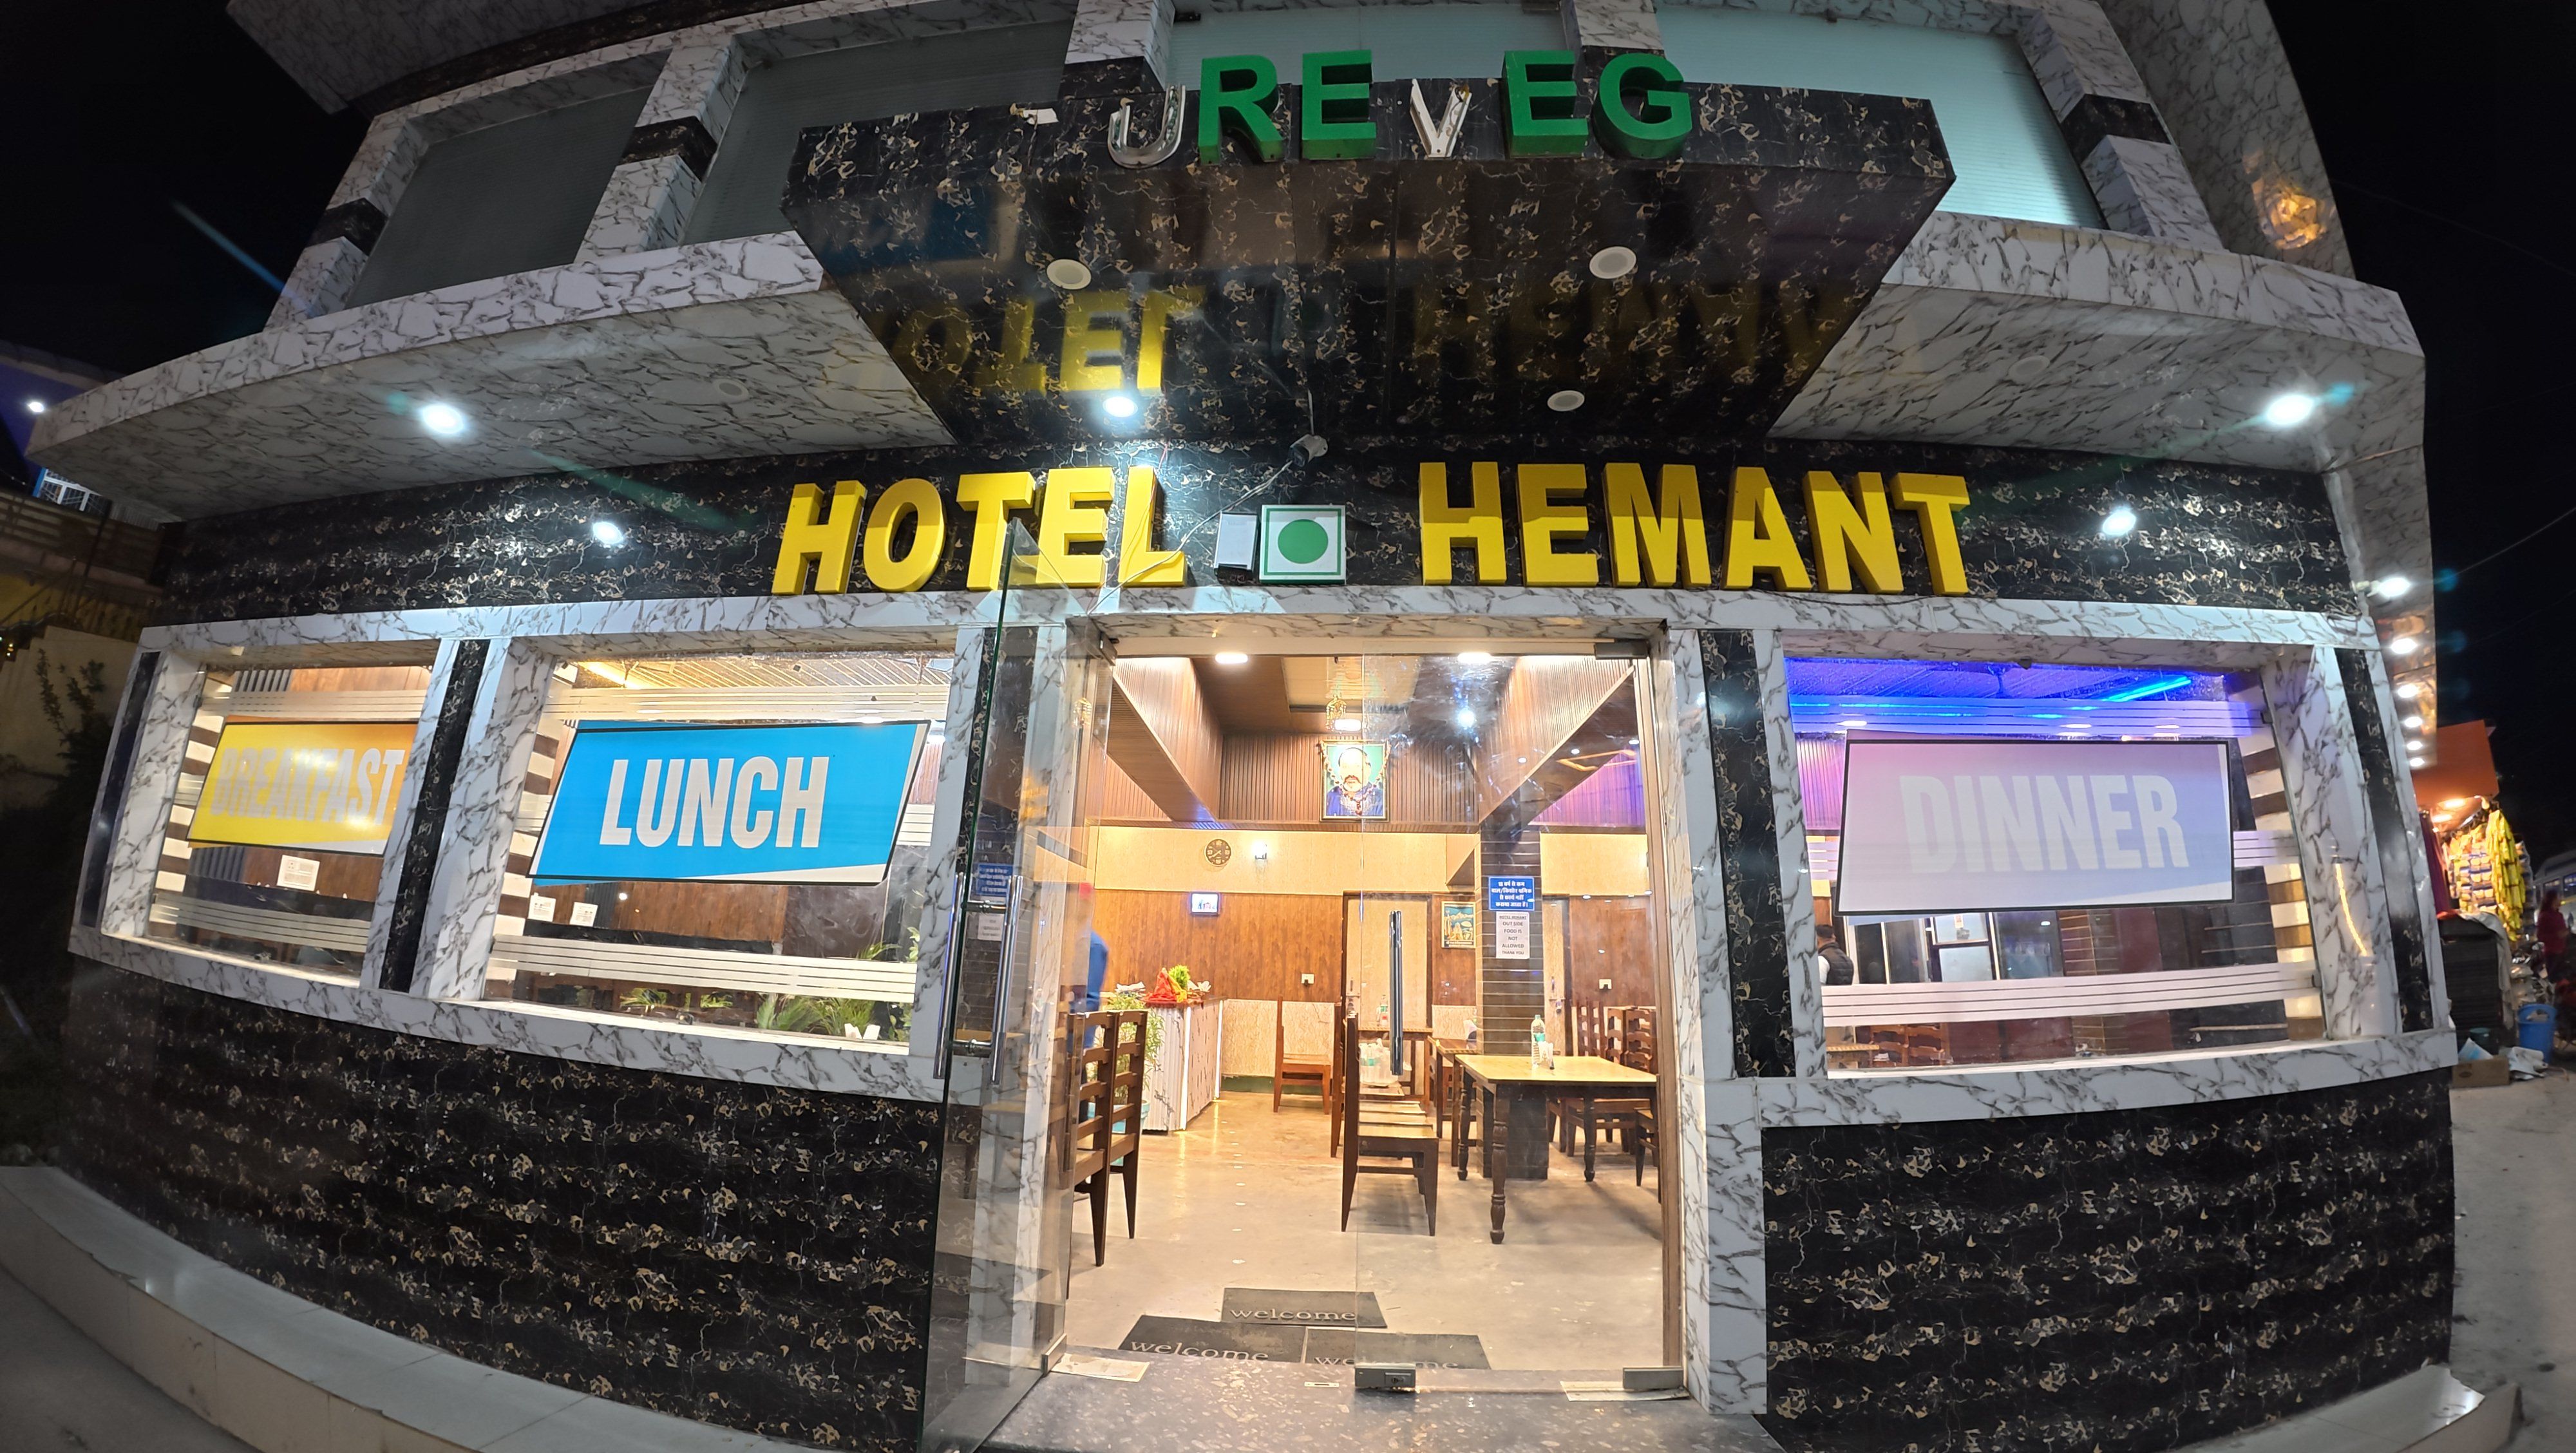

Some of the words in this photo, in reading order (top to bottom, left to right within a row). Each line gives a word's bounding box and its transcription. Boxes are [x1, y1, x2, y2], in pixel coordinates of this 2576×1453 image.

[1410, 50, 1693, 160] VEG
[772, 465, 1187, 594] HOTEL
[1419, 461, 1970, 595] HEMANT
[210, 747, 406, 826] BREAKFAST
[599, 755, 829, 849] LUNCH
[1900, 774, 2190, 874] DINNER
[1131, 1341, 1269, 1360] welcome
[1230, 1308, 1356, 1321] welcome
